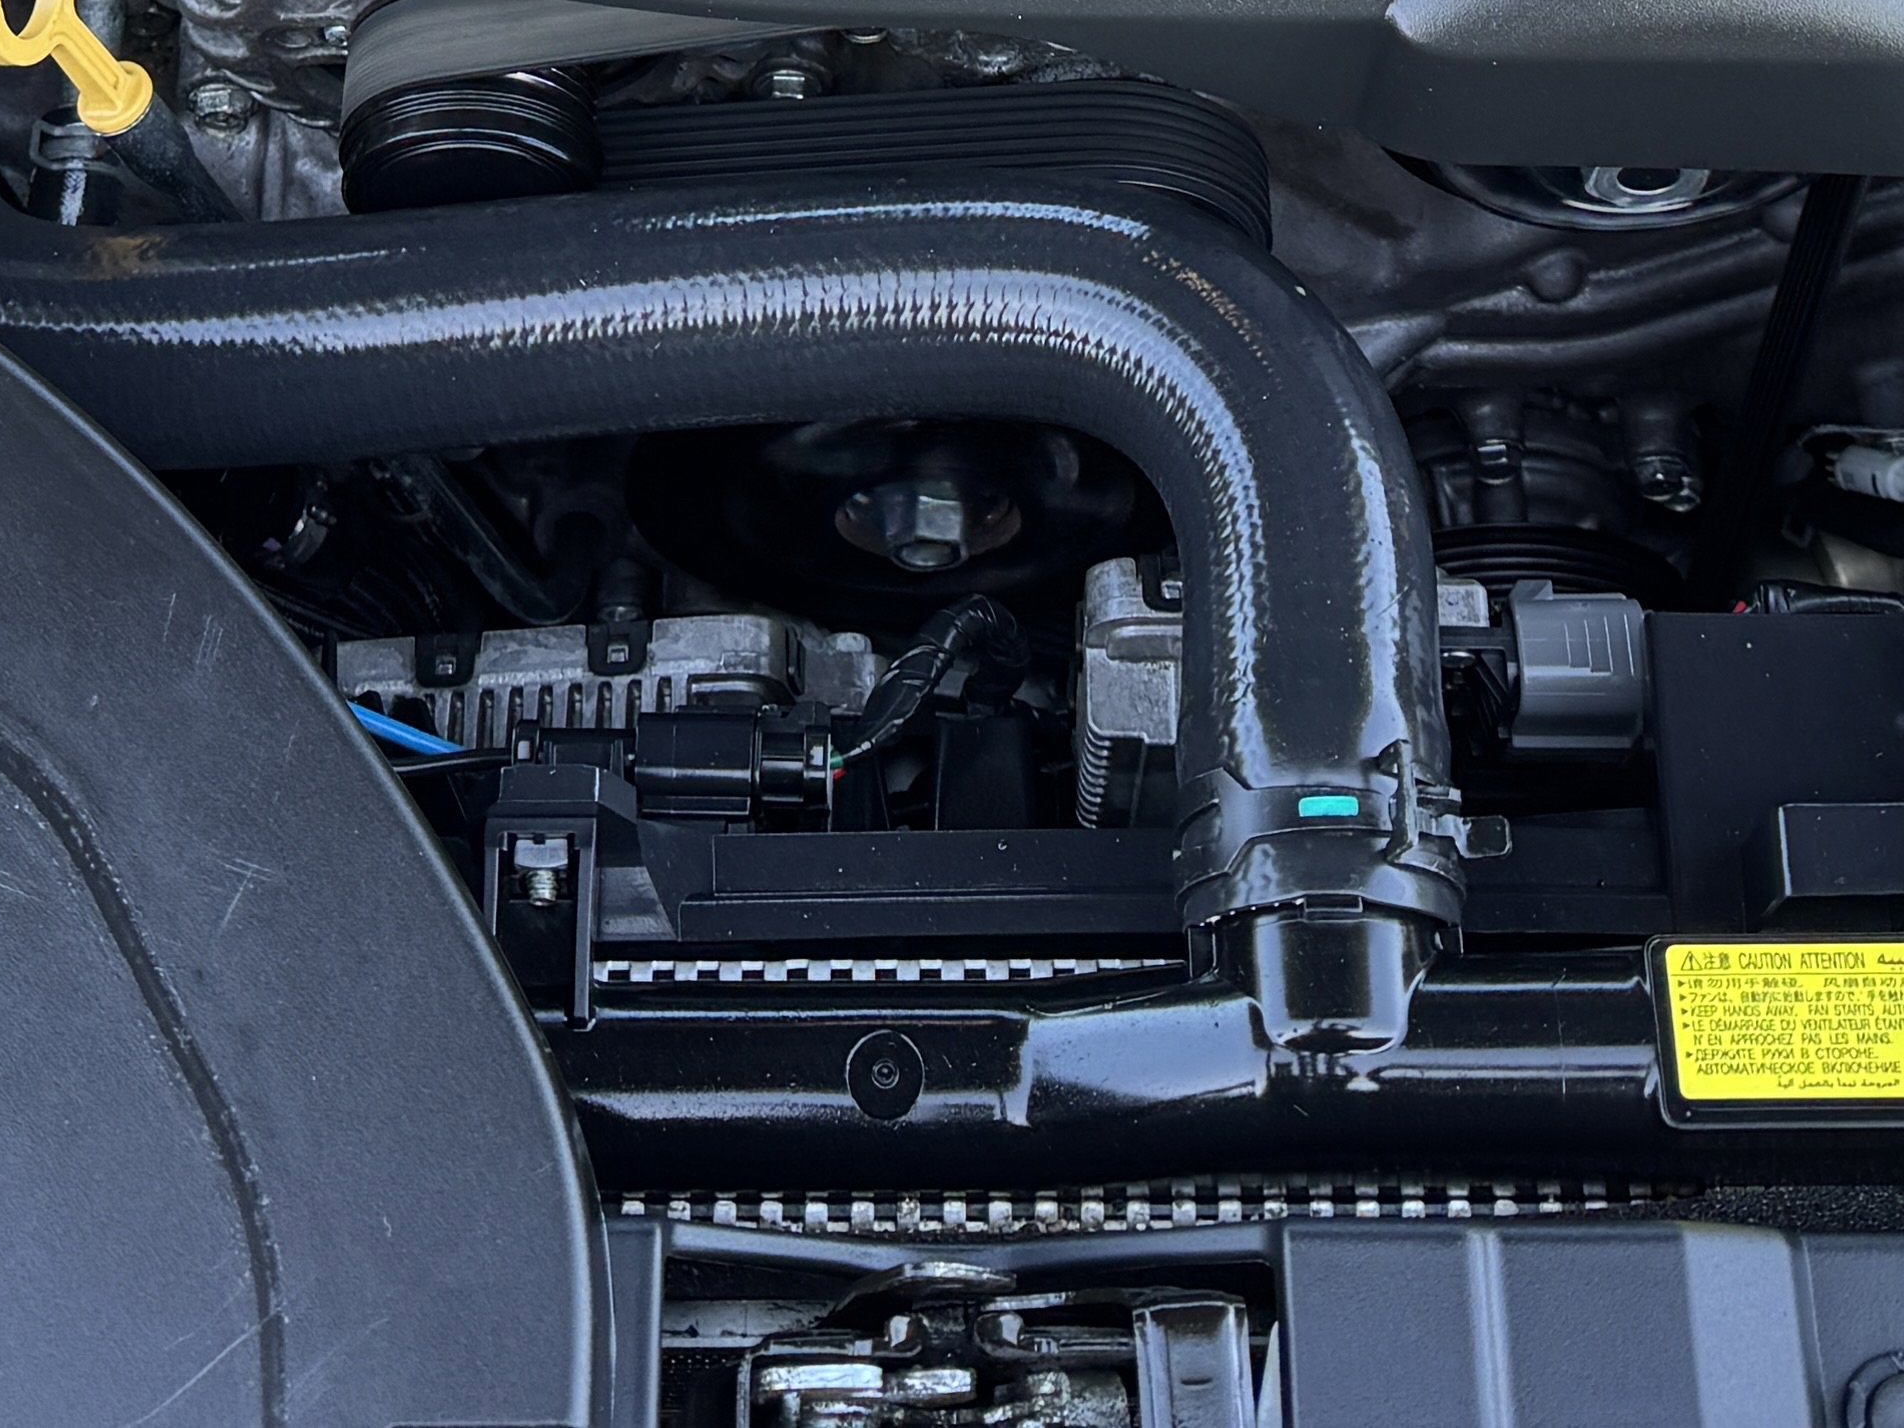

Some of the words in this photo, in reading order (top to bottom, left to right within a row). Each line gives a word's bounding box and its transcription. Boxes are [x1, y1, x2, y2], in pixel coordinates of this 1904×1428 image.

[1701, 951, 1731, 970] 注意
[1738, 952, 1791, 970] CAUTION
[1799, 951, 1865, 970] ATTENTION
[1690, 1004, 1718, 1017] KEEP
[1722, 1005, 1761, 1017] HANDS
[1765, 1005, 1798, 1017] AWAY.
[1807, 1003, 1829, 1015] FAN
[1834, 1003, 1874, 1015] STARTS
[1692, 1020, 1705, 1031] LE
[1709, 1017, 1777, 1032] DÉMARRAGE
[1780, 1020, 1796, 1031] DU
[1801, 1017, 1871, 1031] VENTILATEUR
[1730, 1033, 1793, 1046] APPROCHEZ
[1801, 1033, 1821, 1044] PAS
[1829, 1033, 1848, 1044] LES
[1856, 1032, 1893, 1045] MAINS.
[1694, 1048, 1756, 1063] ДЕРЖИТЕ
[1762, 1048, 1795, 1060] РУКИ
[1800, 1047, 1809, 1058] В
[1815, 1046, 1878, 1059] СТОРОНЕ.
[1696, 1061, 1814, 1074] АВТОМАТИЧЕСКОЕ
[1822, 1060, 1901, 1075] ВКЛЮЧЕНИЕ
